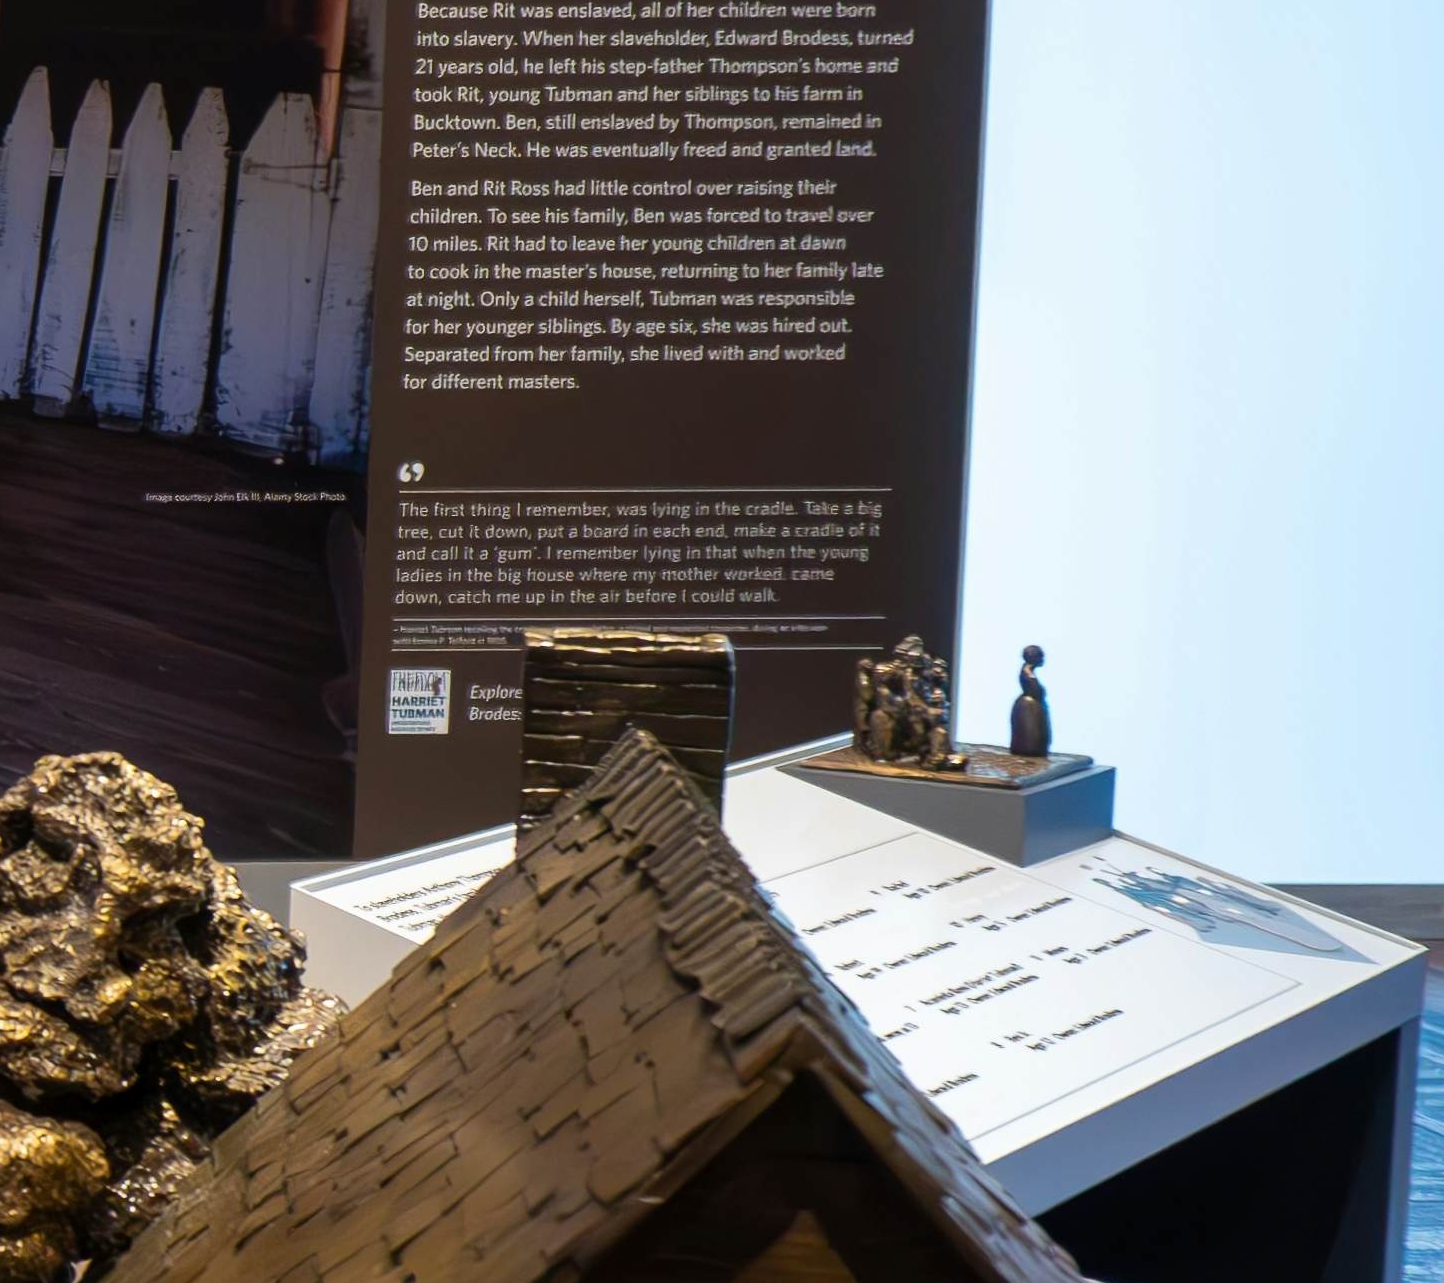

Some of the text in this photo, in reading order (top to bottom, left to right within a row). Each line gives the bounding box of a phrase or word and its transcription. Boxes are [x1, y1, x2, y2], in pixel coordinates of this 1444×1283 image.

[411, 179, 837, 199] Ben and Rit Ross had little control over raising their
[396, 566, 719, 586] ladies in the big house where my mother
[392, 696, 446, 706] HARRIET
[469, 684, 523, 702] Explore
[470, 706, 521, 721] Brodes
